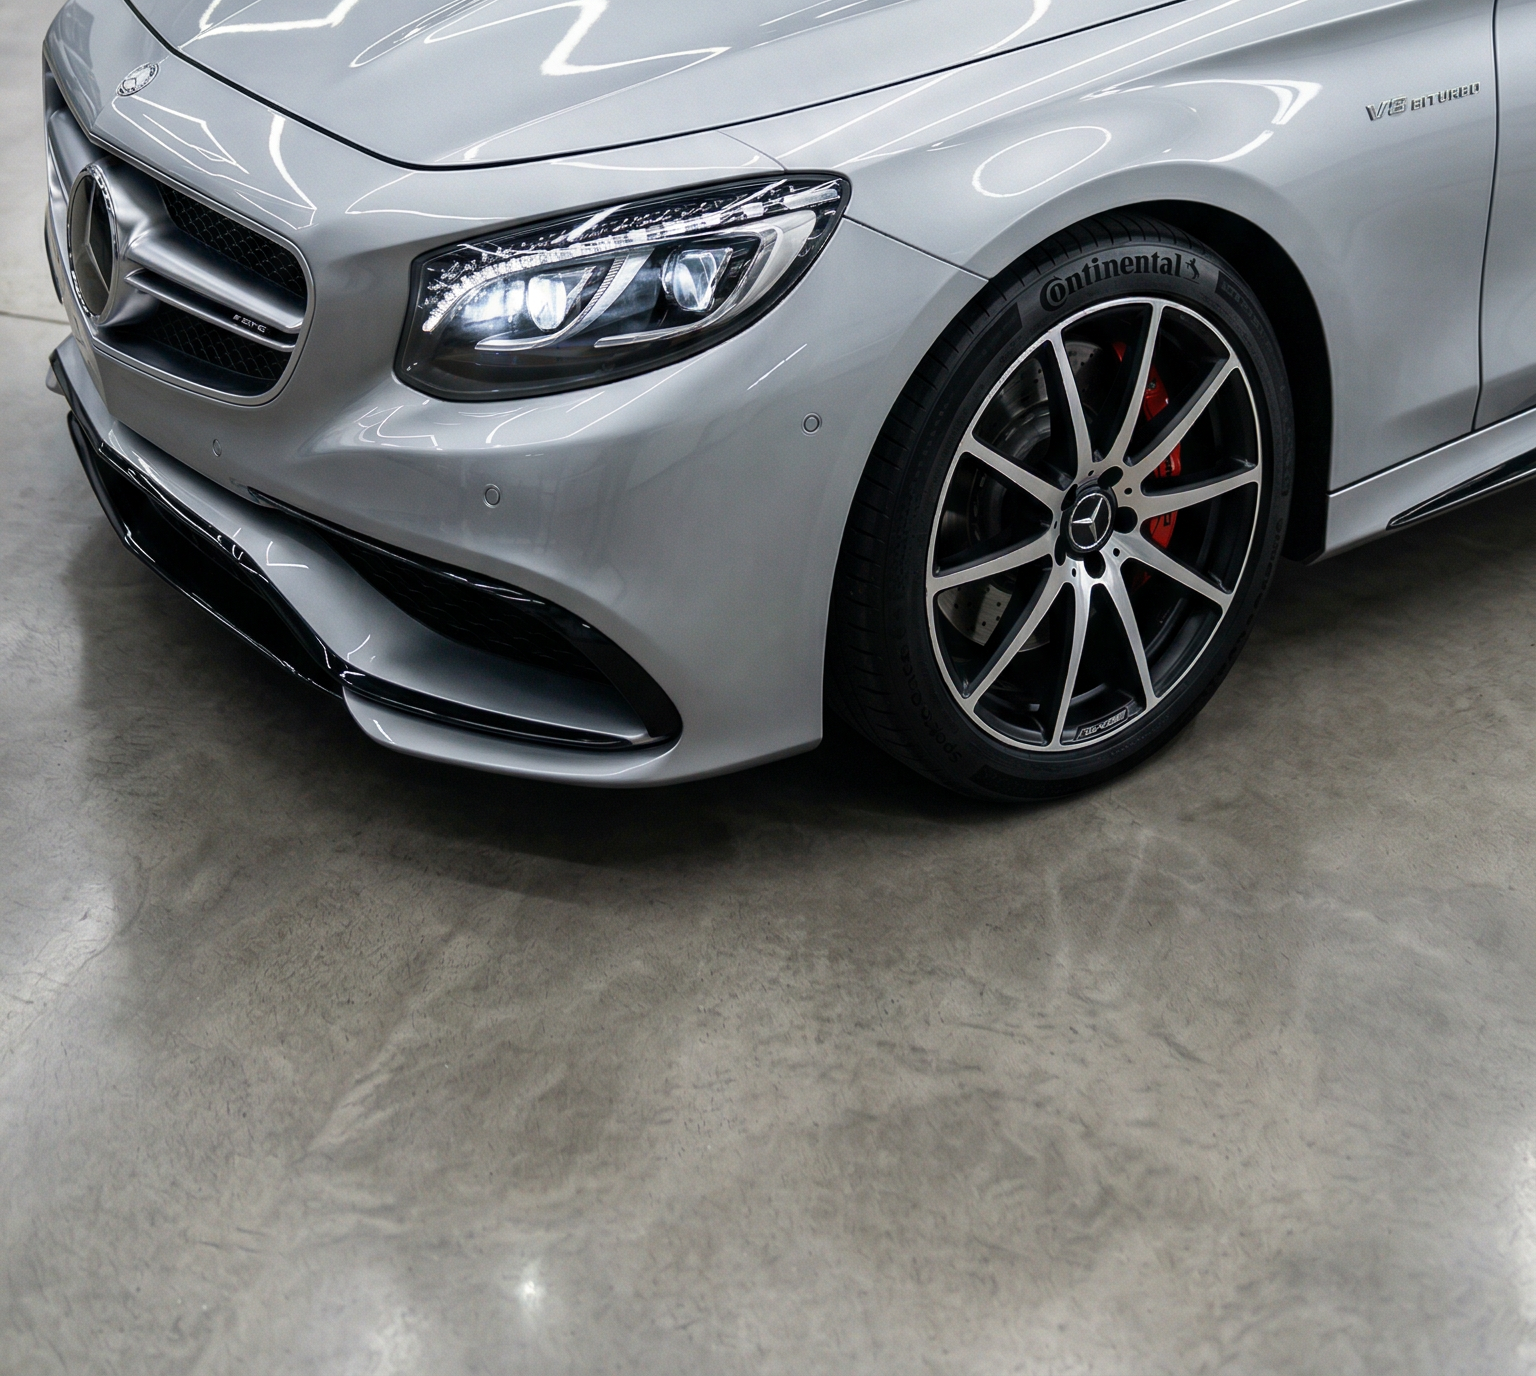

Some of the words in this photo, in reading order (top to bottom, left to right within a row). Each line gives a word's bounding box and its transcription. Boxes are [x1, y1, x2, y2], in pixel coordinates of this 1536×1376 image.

[1365, 94, 1408, 121] V8
[1411, 81, 1481, 111] BITURBO
[1039, 251, 1182, 312] Continental
